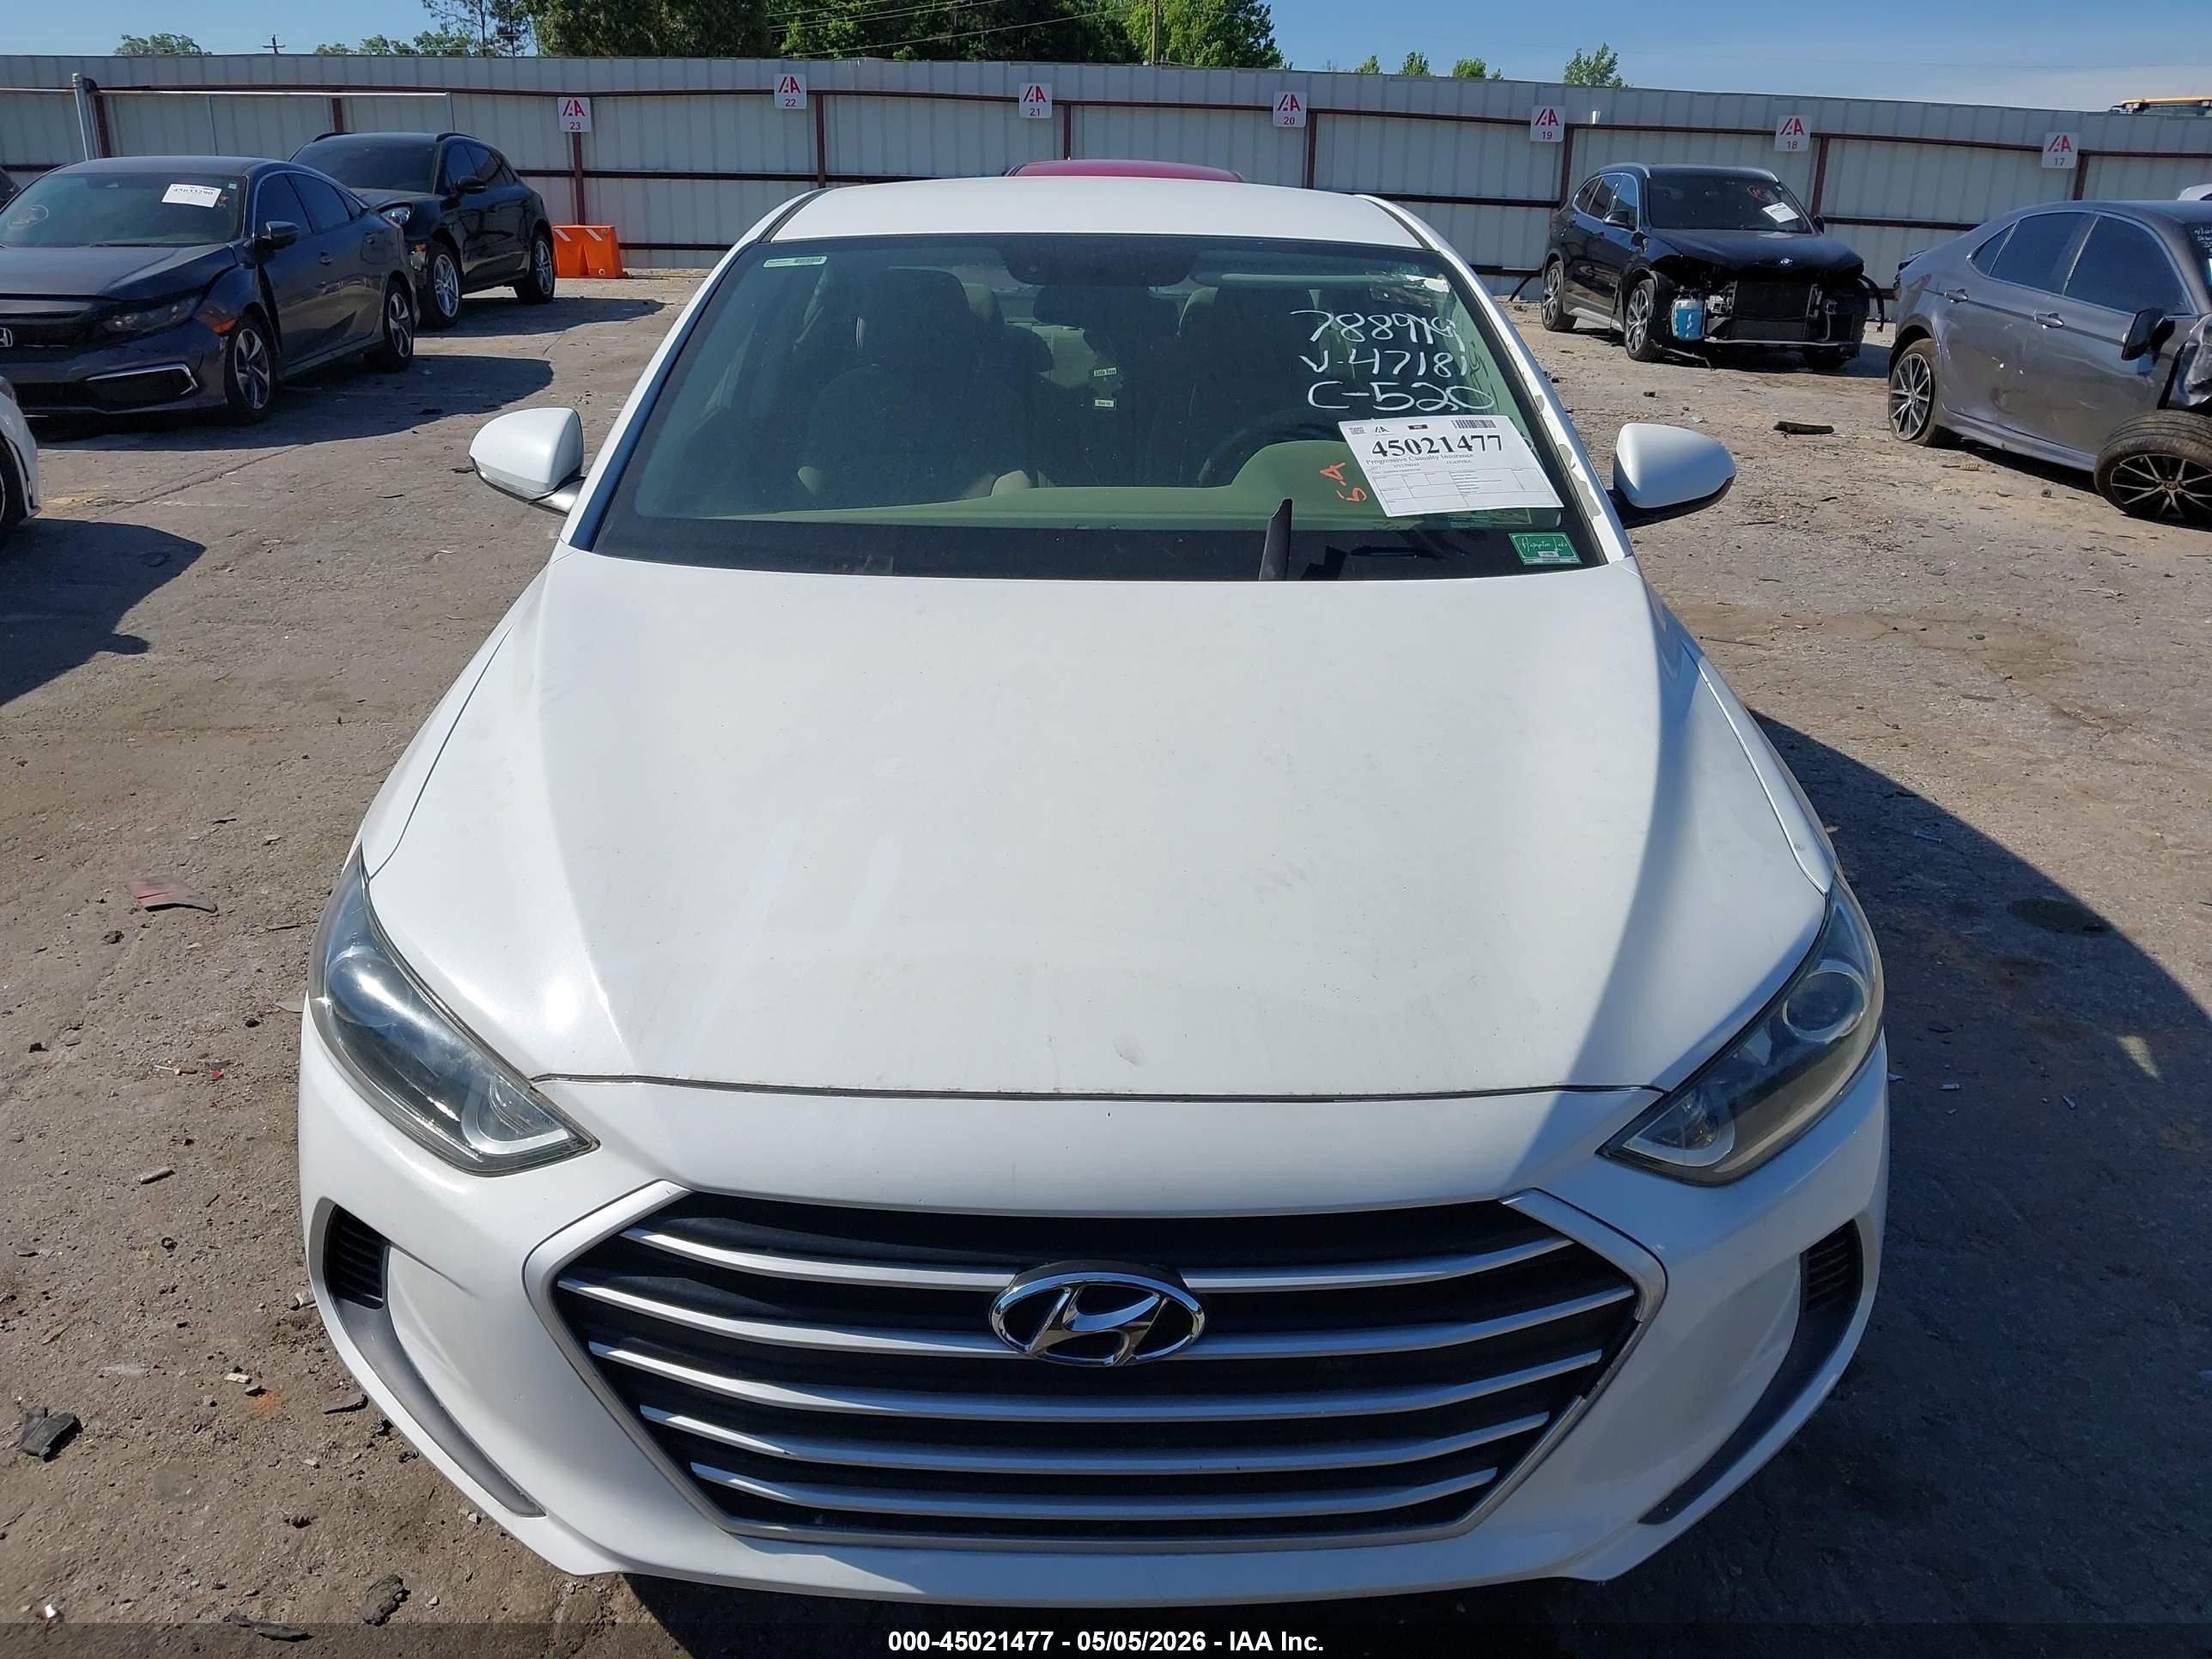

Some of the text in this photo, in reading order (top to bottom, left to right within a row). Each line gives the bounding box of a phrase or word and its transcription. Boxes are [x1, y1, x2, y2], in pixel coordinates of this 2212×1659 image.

[785, 99, 796, 107] 22
[1030, 107, 1040, 116] 21
[1284, 116, 1295, 125] 20
[570, 122, 580, 131] 23
[1541, 131, 1553, 140] 19
[1787, 141, 1798, 149] 18
[2054, 158, 2065, 167] 17
[1308, 381, 1495, 411] C-520
[1372, 434, 1502, 458] 45021477
[1365, 457, 1407, 465] Progressive
[1408, 454, 1439, 463] Casualty
